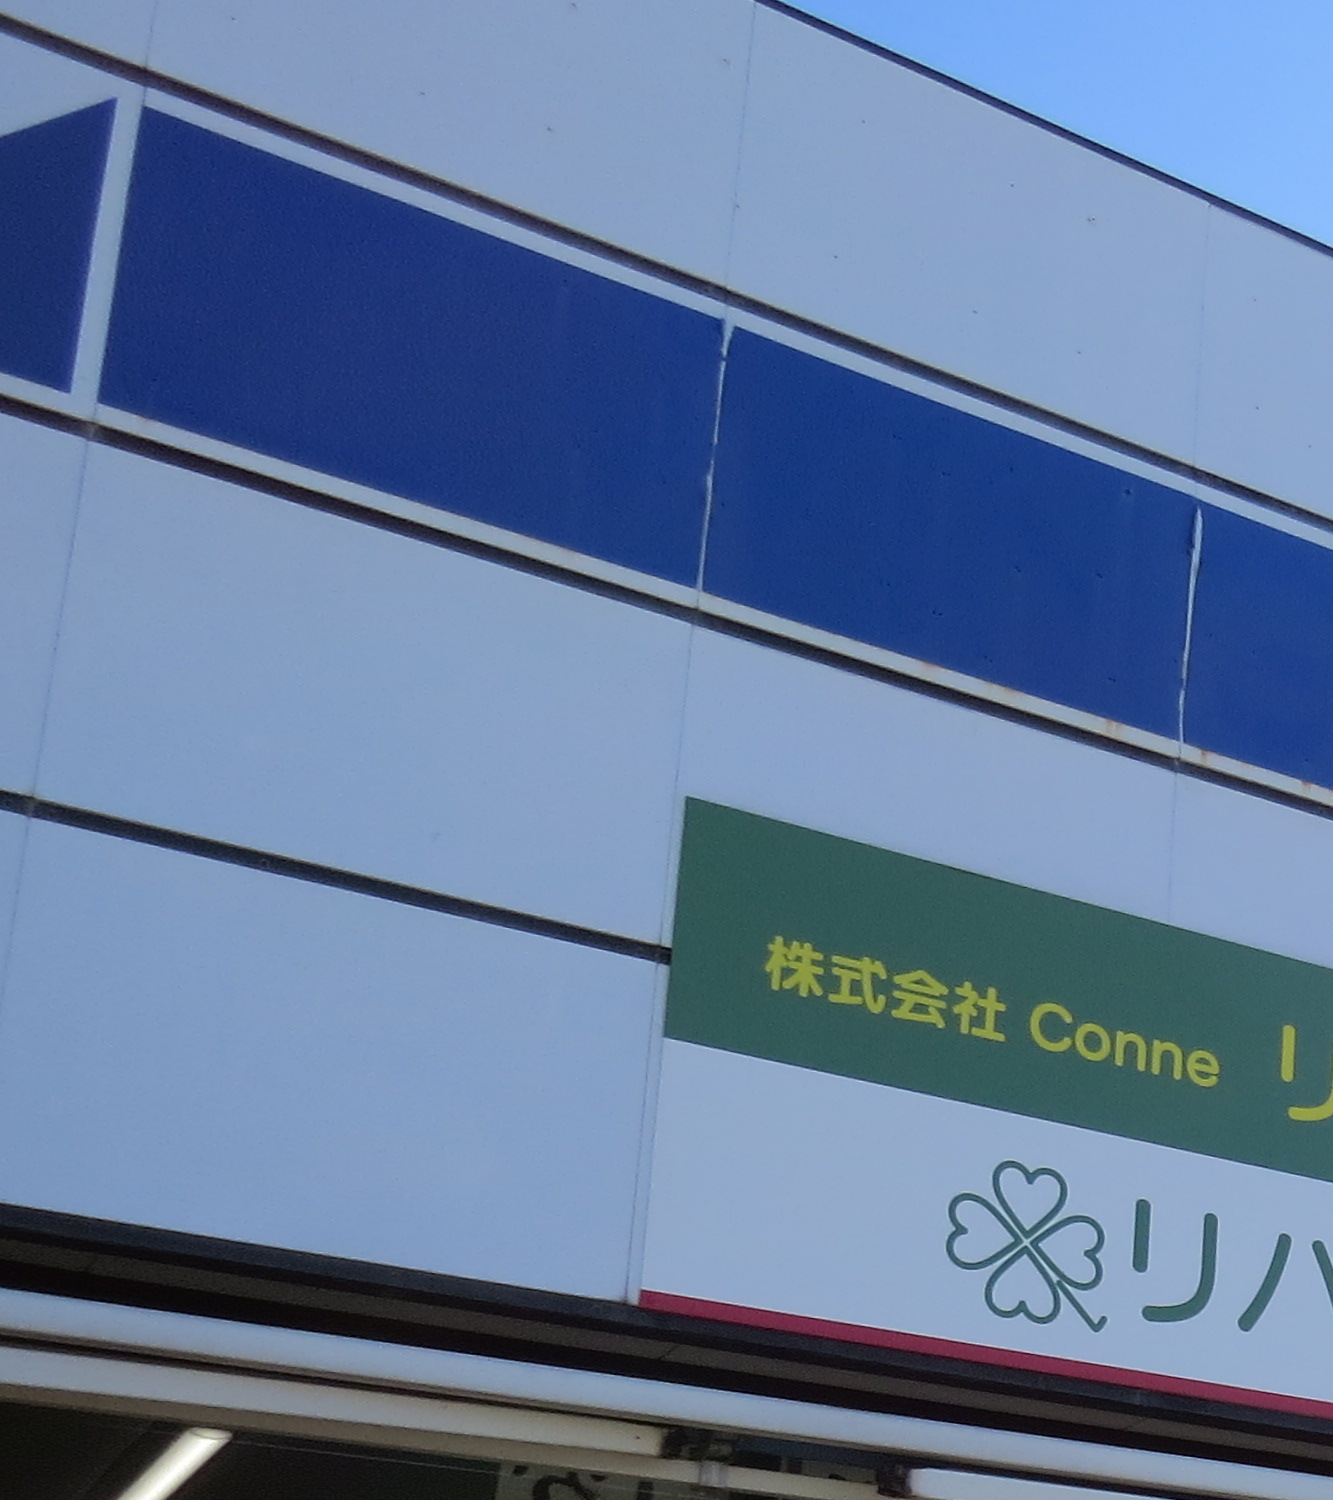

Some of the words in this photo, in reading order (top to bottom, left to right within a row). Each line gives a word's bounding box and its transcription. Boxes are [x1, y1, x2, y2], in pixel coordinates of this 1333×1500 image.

[764, 936, 1007, 1043] 株式会社
[1029, 1003, 1221, 1088] Conne
